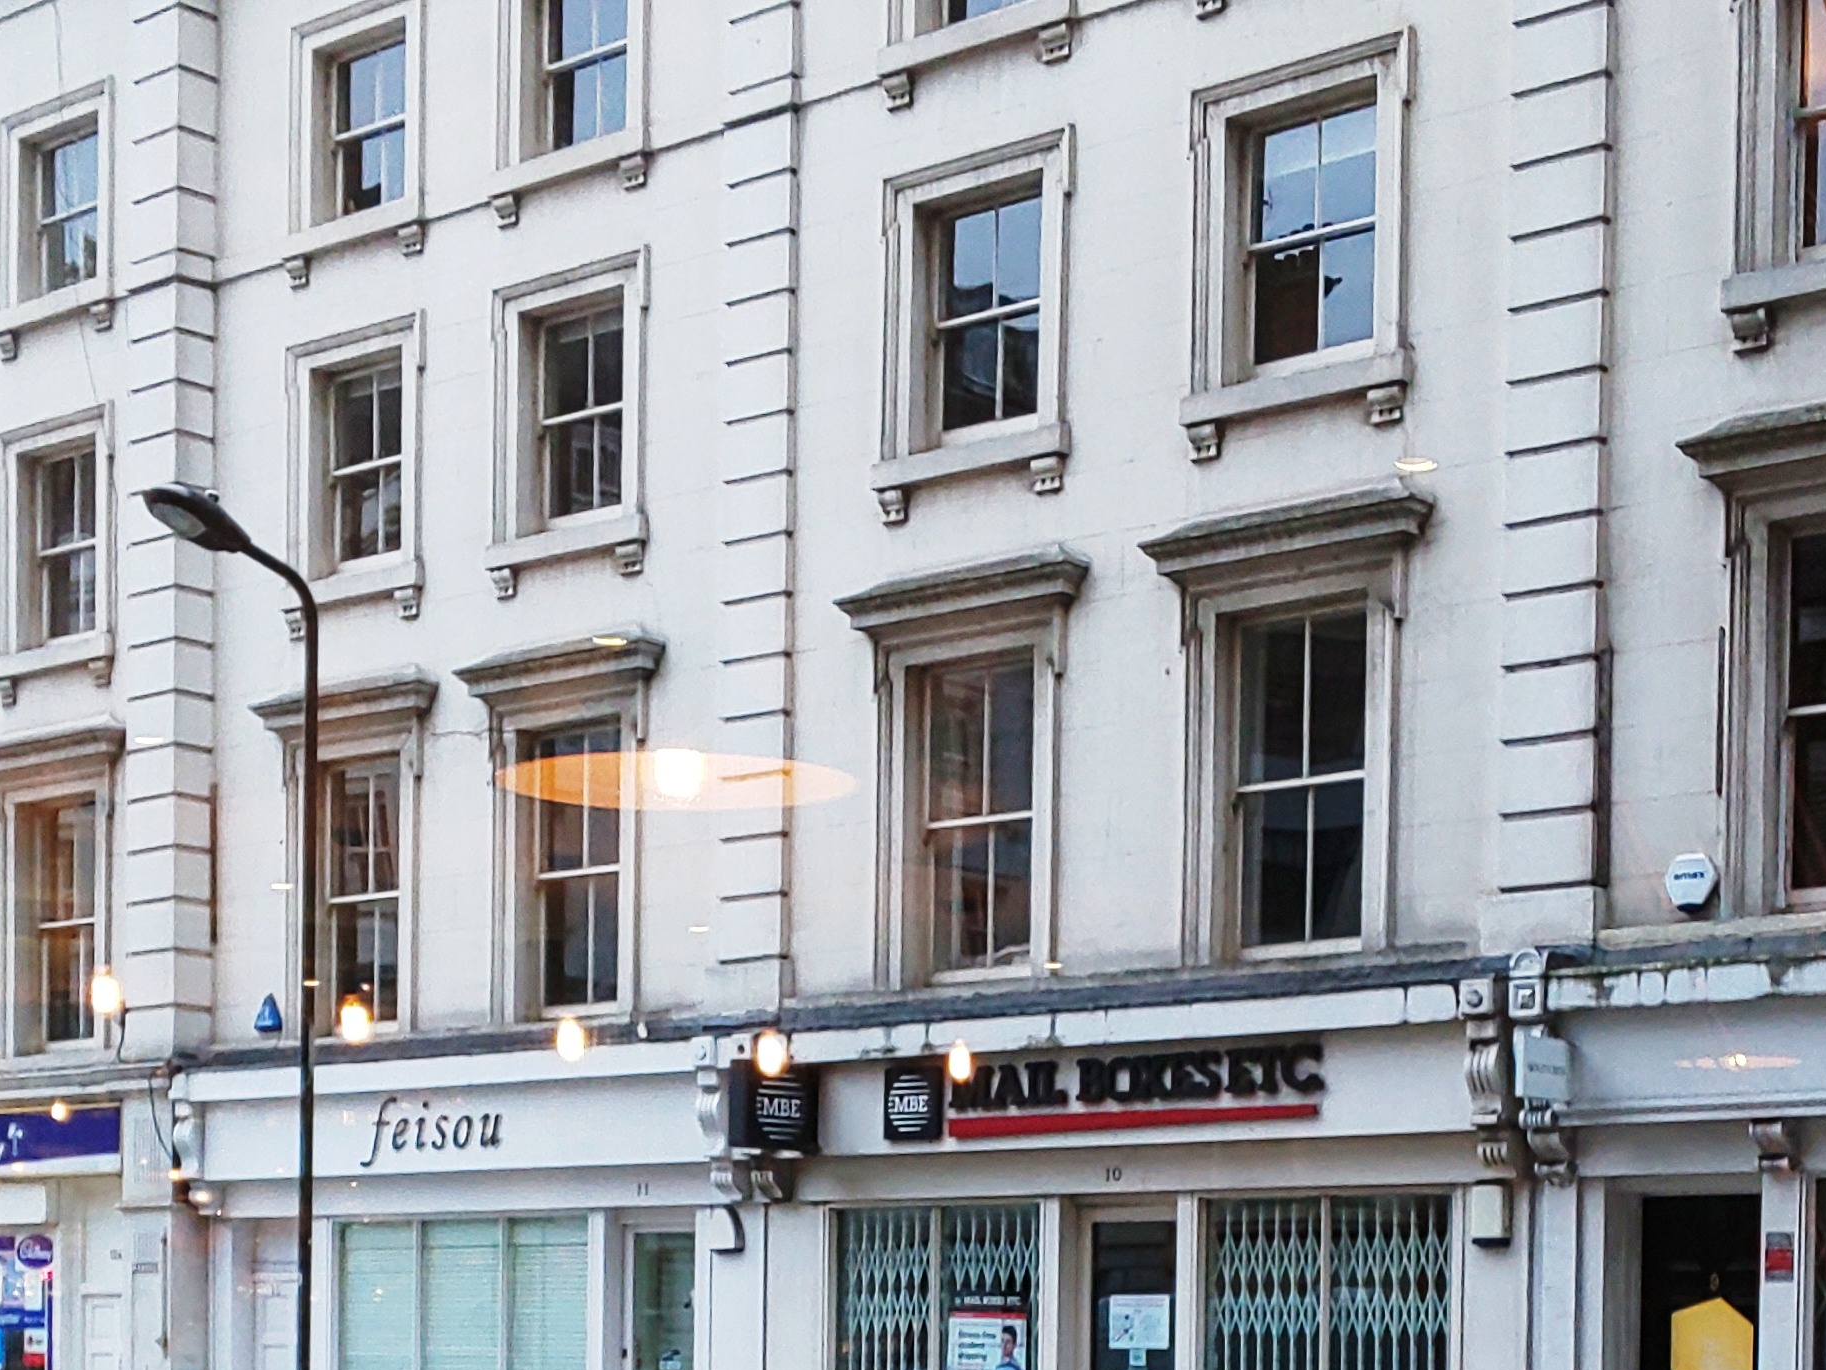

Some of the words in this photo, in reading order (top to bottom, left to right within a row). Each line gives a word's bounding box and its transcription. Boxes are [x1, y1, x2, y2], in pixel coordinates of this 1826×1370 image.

[949, 1060, 1069, 1110] MAIL
[1077, 1050, 1223, 1102] BOXES
[1224, 1042, 1326, 1096] ETC
[359, 1096, 503, 1168] feisou
[1105, 1166, 1122, 1182] 10
